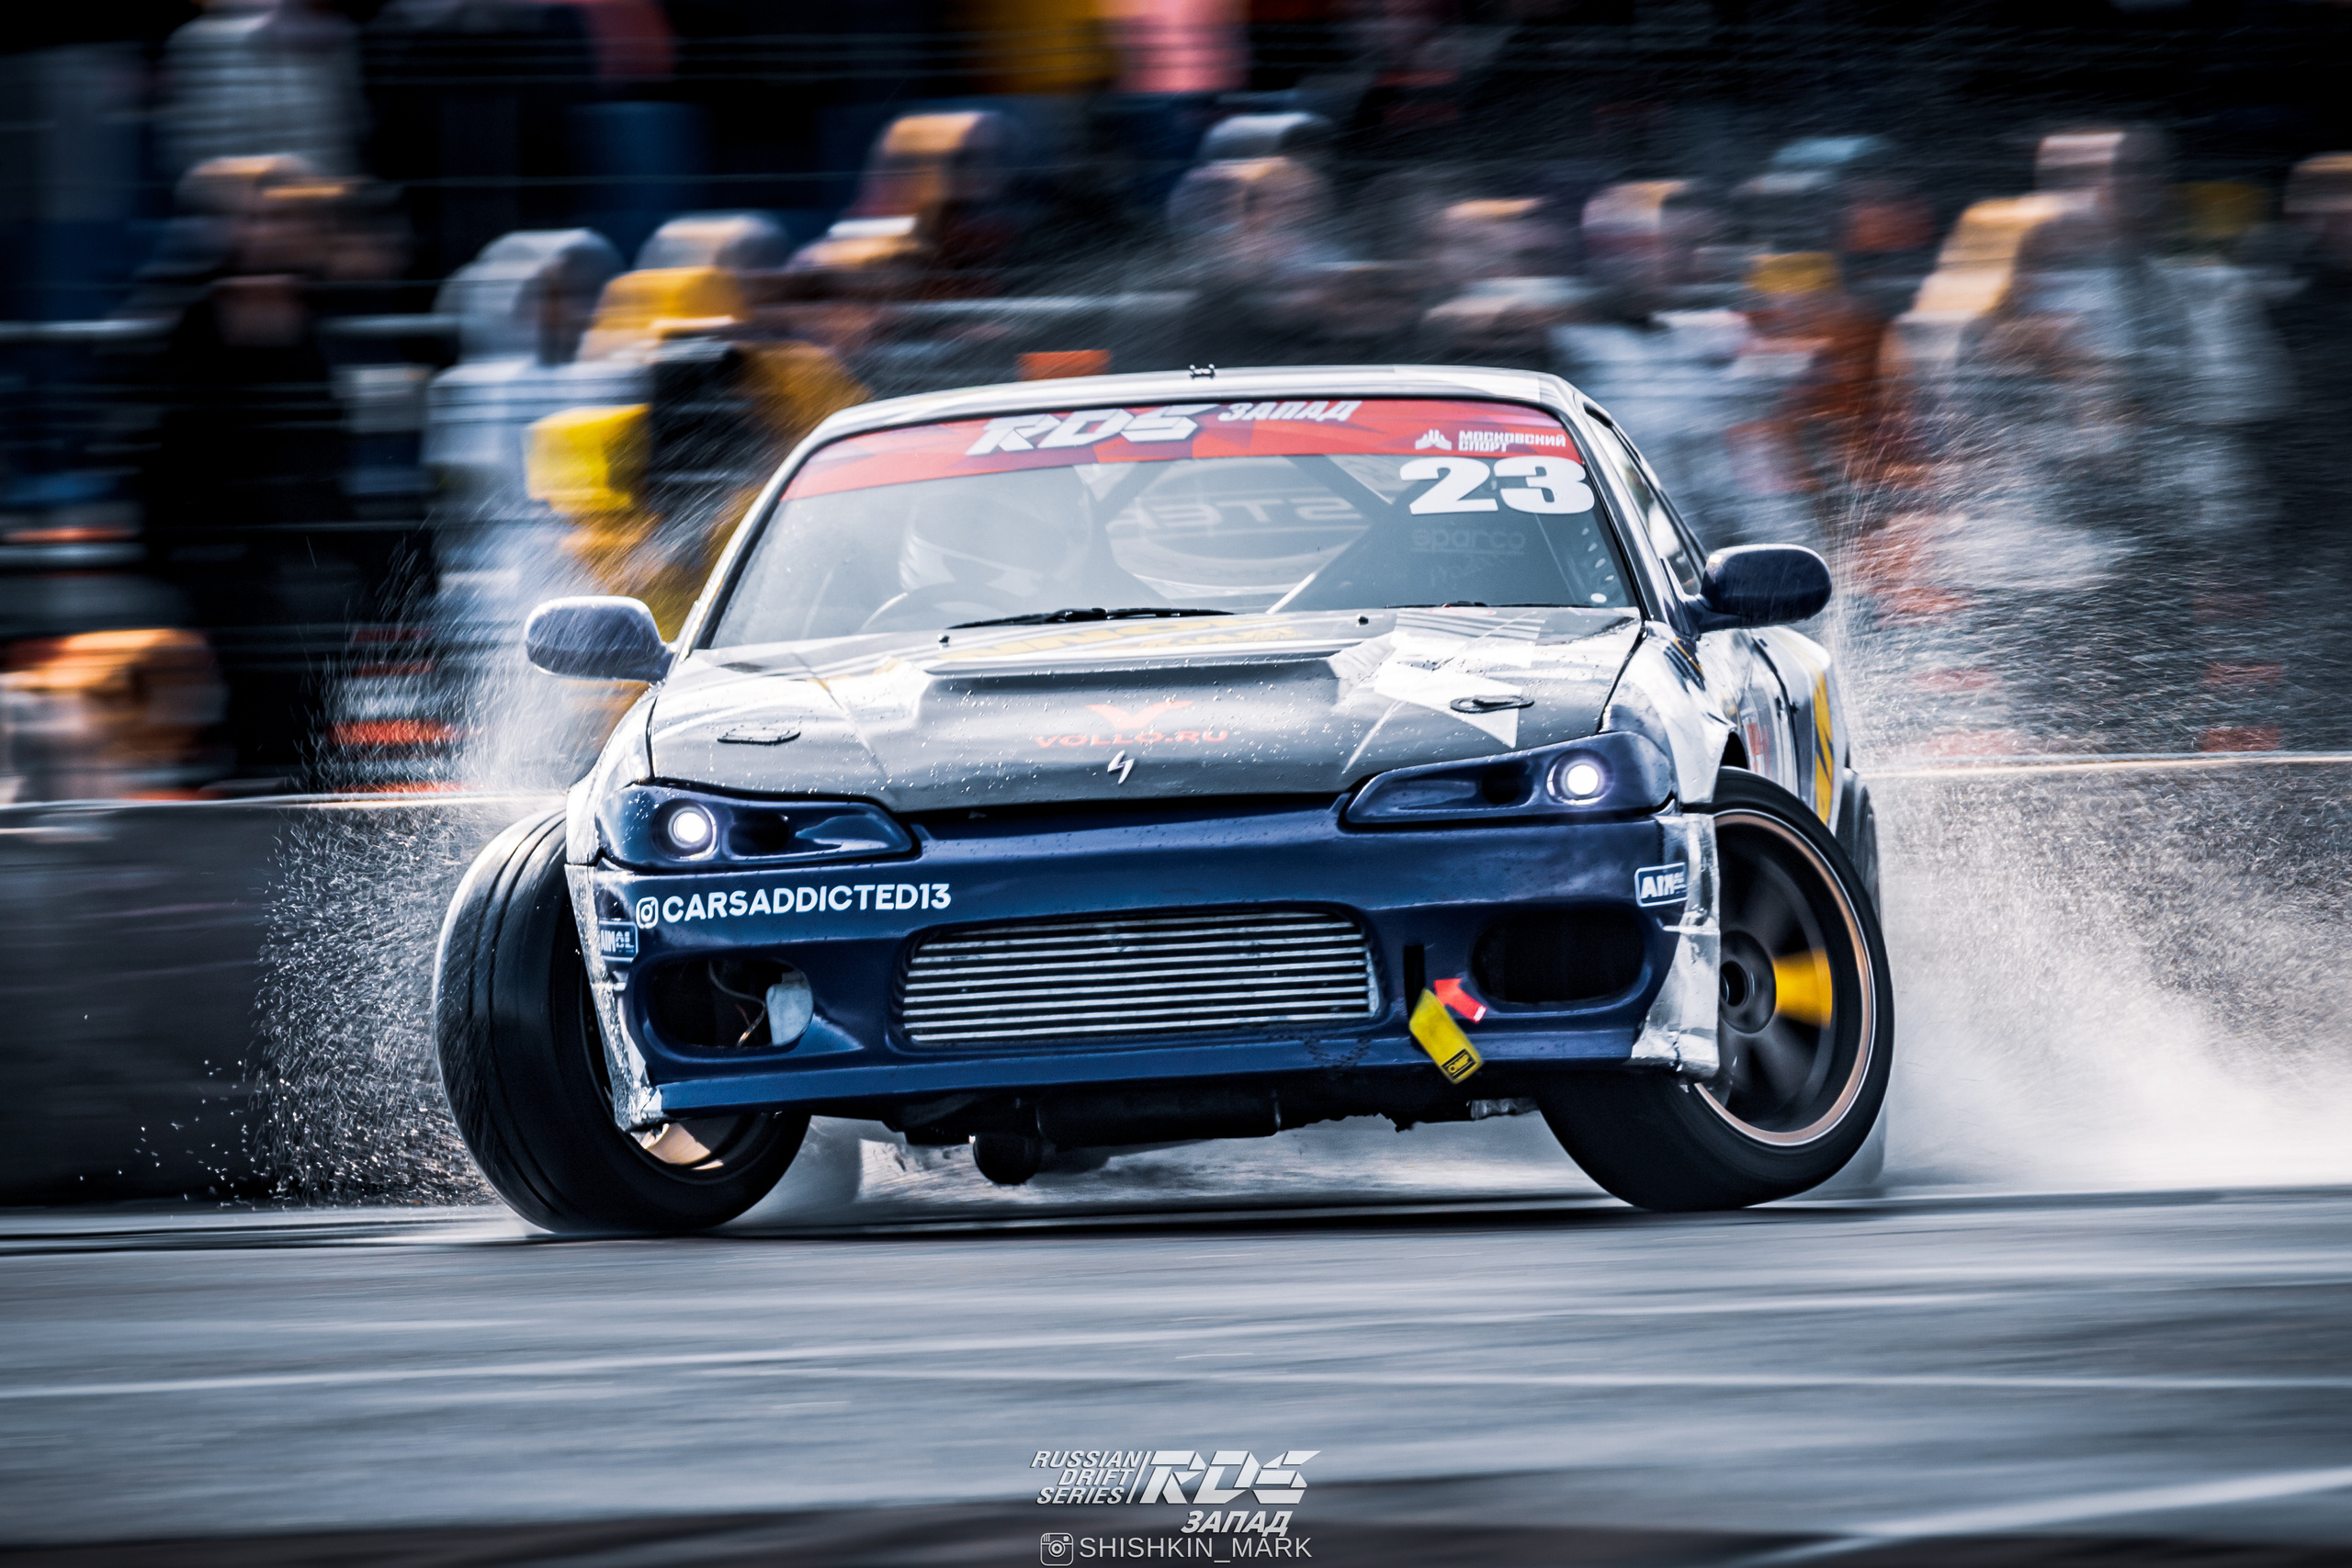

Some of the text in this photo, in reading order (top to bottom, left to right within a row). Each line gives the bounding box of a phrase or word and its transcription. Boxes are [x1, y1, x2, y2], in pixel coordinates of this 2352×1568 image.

[1217, 400, 1363, 422] ЗАПАД
[966, 403, 1219, 457] RDS
[1458, 429, 1566, 447] МОСКОВСКИЙ
[1458, 440, 1511, 453] СПОРТ
[1399, 455, 1595, 515] 23
[1035, 729, 1228, 749] VOLLO.RU
[662, 882, 952, 923] CARSADDICTED13
